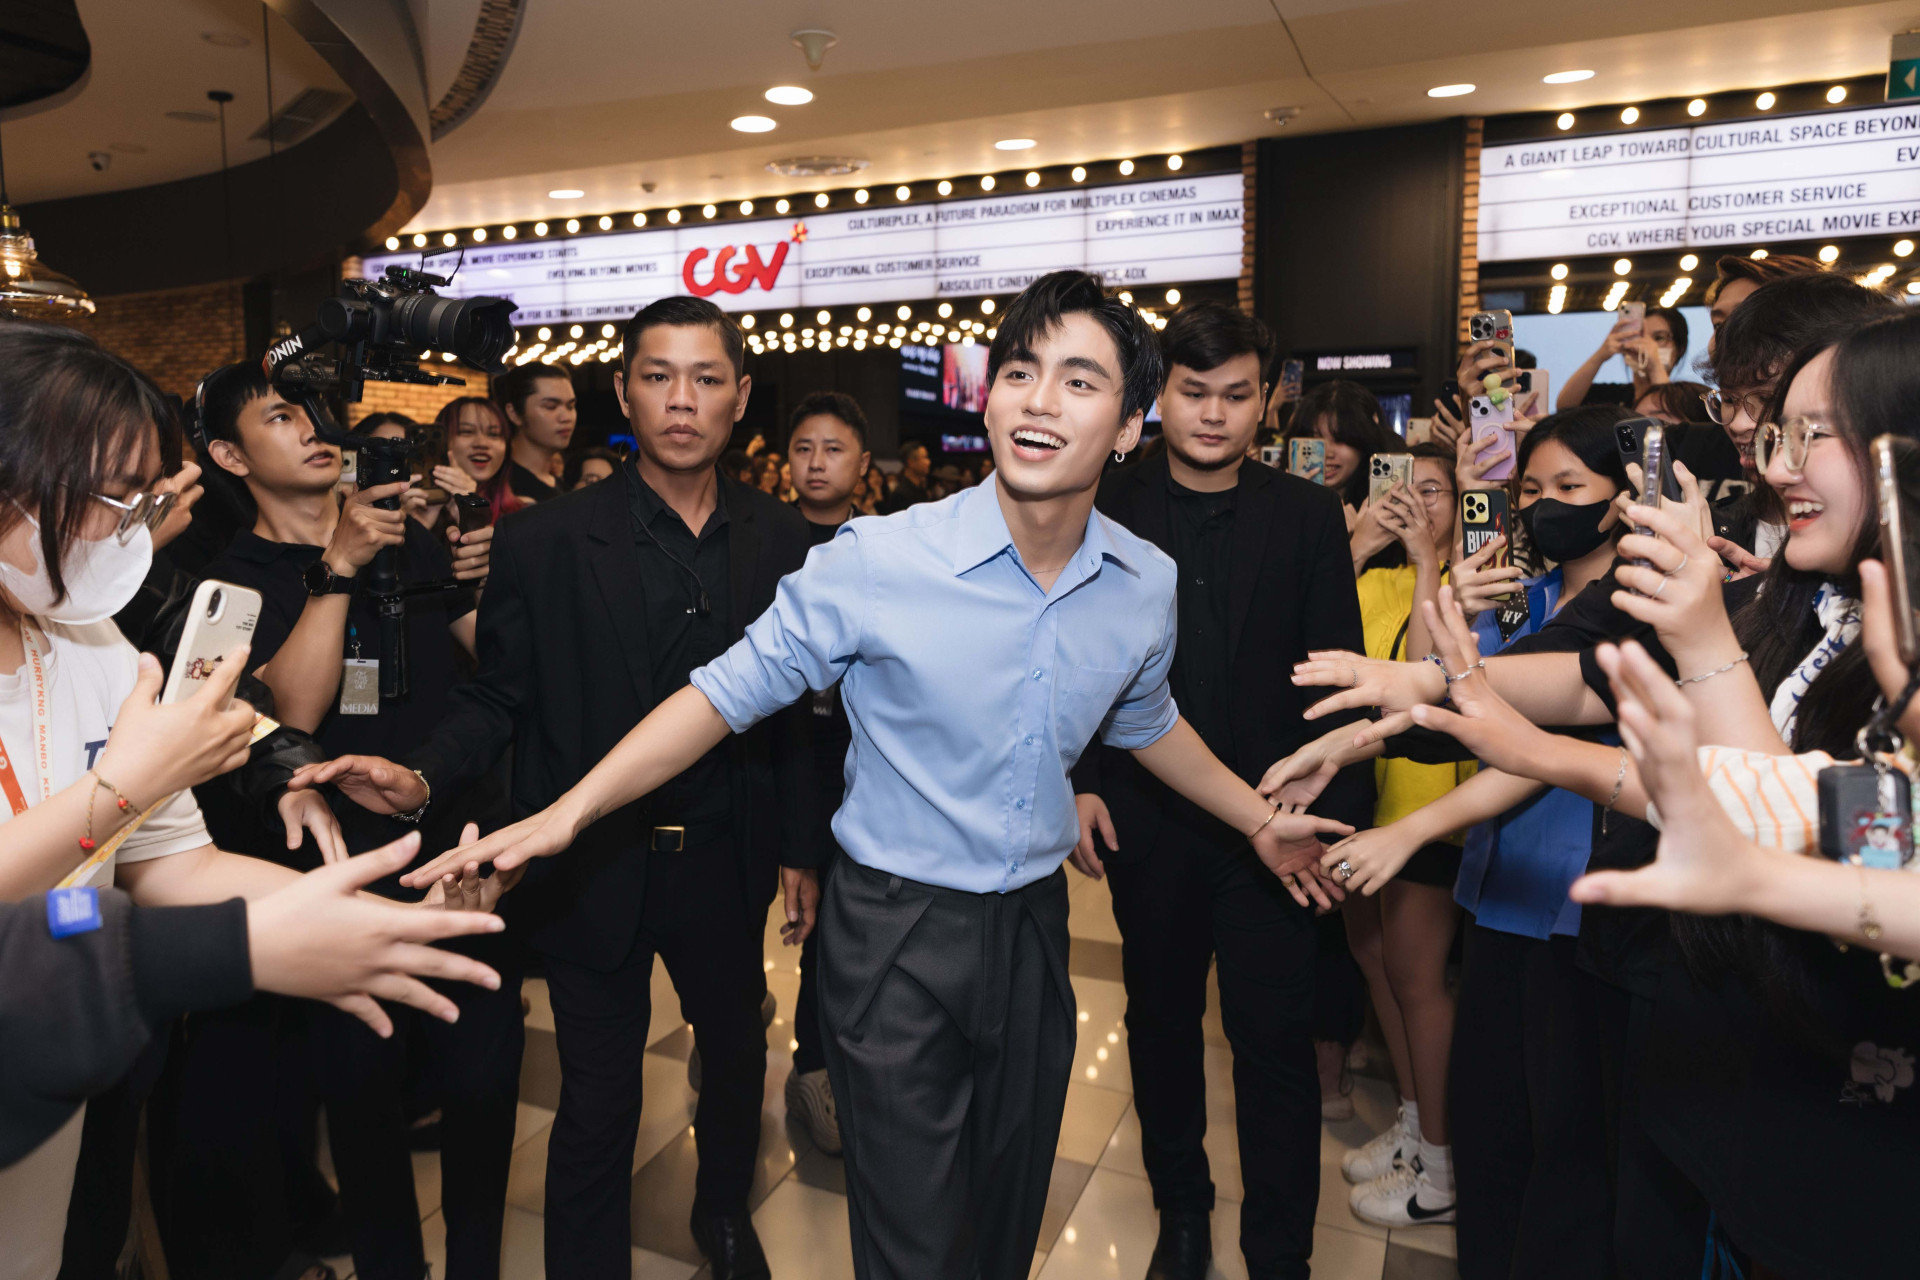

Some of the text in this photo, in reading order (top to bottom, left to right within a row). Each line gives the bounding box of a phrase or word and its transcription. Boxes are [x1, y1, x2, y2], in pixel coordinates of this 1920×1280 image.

[1505, 114, 1920, 168] A GIANT LEAP TOWARD CULTURAL SPACE BEYON
[848, 186, 1197, 230] CULTUREPLEX, A FUTURE PARADIGM FOR MULTIPLEX CINEMAS
[1569, 183, 1867, 219] EXCEPTIONAL CUSTOMER SERVICE
[1096, 208, 1240, 232] EXPERIENCE IT IN IMAX
[1587, 232, 1621, 248] CGV,
[1627, 227, 1686, 244] WHERE
[1691, 224, 1736, 240] YOUR
[1742, 218, 1815, 237] SPECIAL
[1823, 212, 1881, 231] MOVIE
[683, 241, 789, 297] CGV
[805, 256, 981, 279] EXCEPTIONAL CUSTOMER SERVICE
[938, 277, 993, 291] ABSOLUTE
[31, 649, 45, 717] HURRYKNG
[39, 725, 48, 769] MANBO
[342, 703, 377, 713] MEDIA
